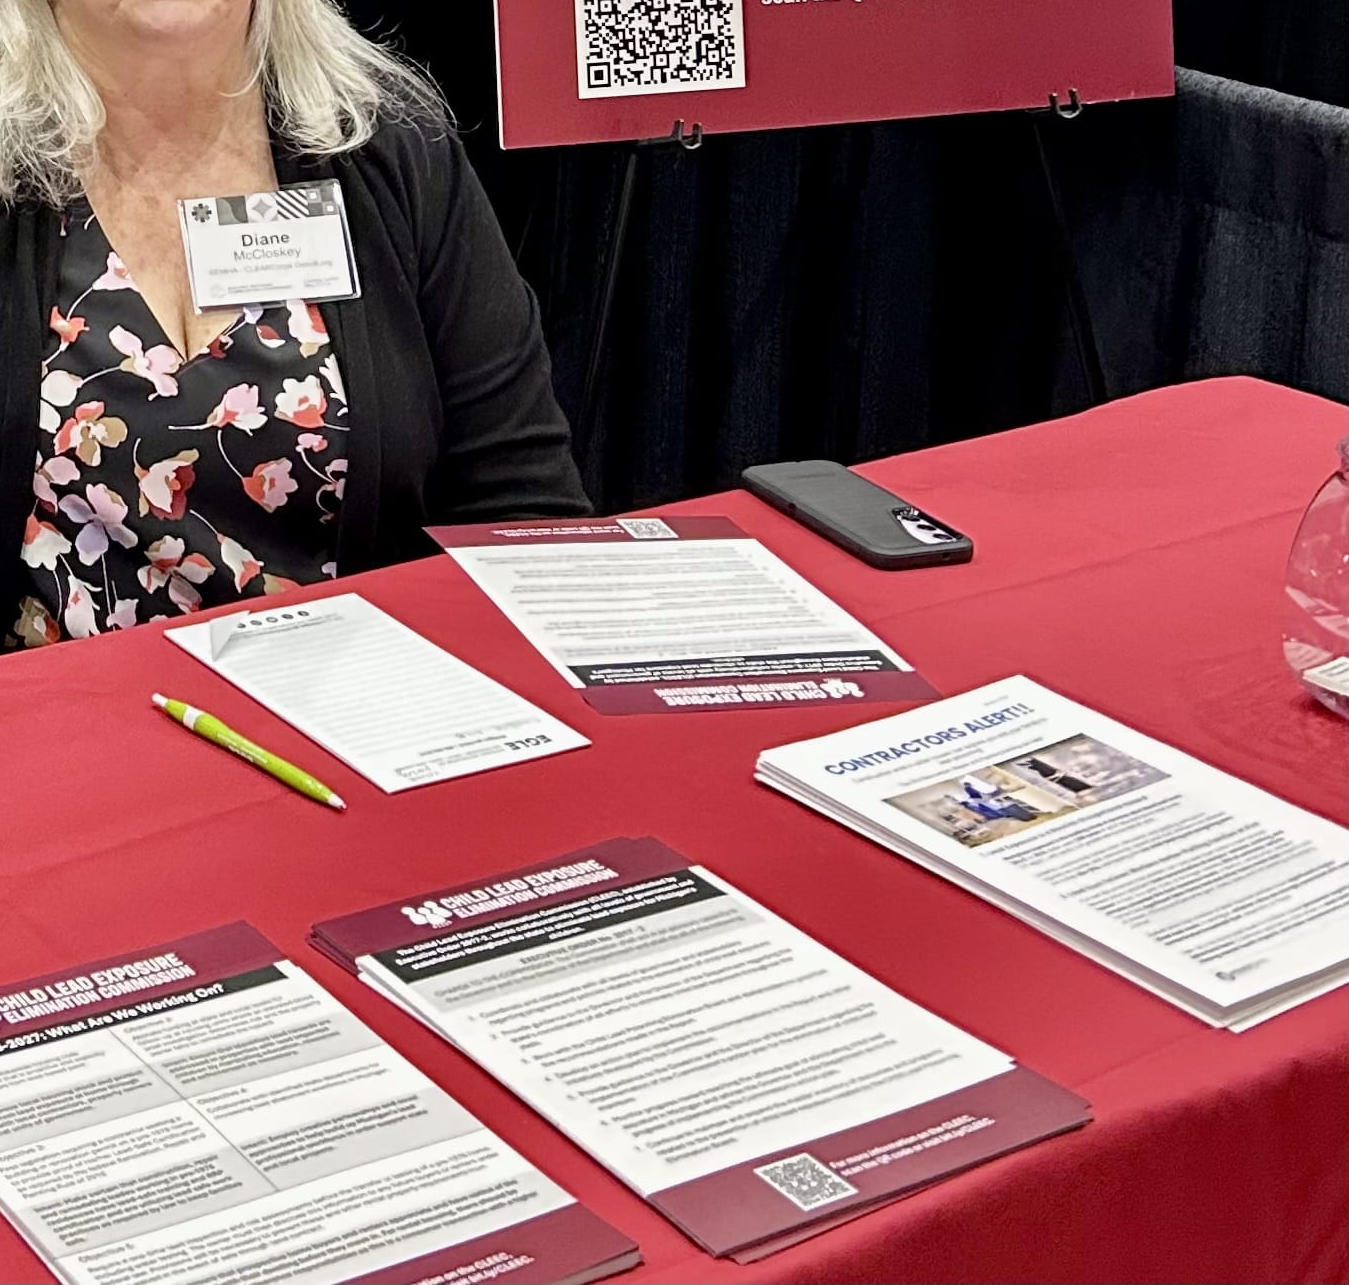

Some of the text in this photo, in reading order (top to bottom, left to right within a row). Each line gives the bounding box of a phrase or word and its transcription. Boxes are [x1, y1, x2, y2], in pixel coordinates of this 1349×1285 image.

[234, 247, 301, 262] McCloskey
[242, 233, 290, 246] Diane
[504, 735, 552, 748] EGLE
[824, 728, 967, 775] CONTRACTORS
[964, 703, 1034, 733] ALERT!!
[2, 965, 196, 1024] ELIMINATION COMMISSION
[46, 977, 94, 1000] LEAD
[91, 952, 184, 986] EXPOSURE
[46, 1020, 88, 1039] What
[88, 1013, 114, 1030] Are
[111, 1008, 138, 1023] We
[139, 992, 199, 1016] Working
[195, 983, 225, 1000] On?
